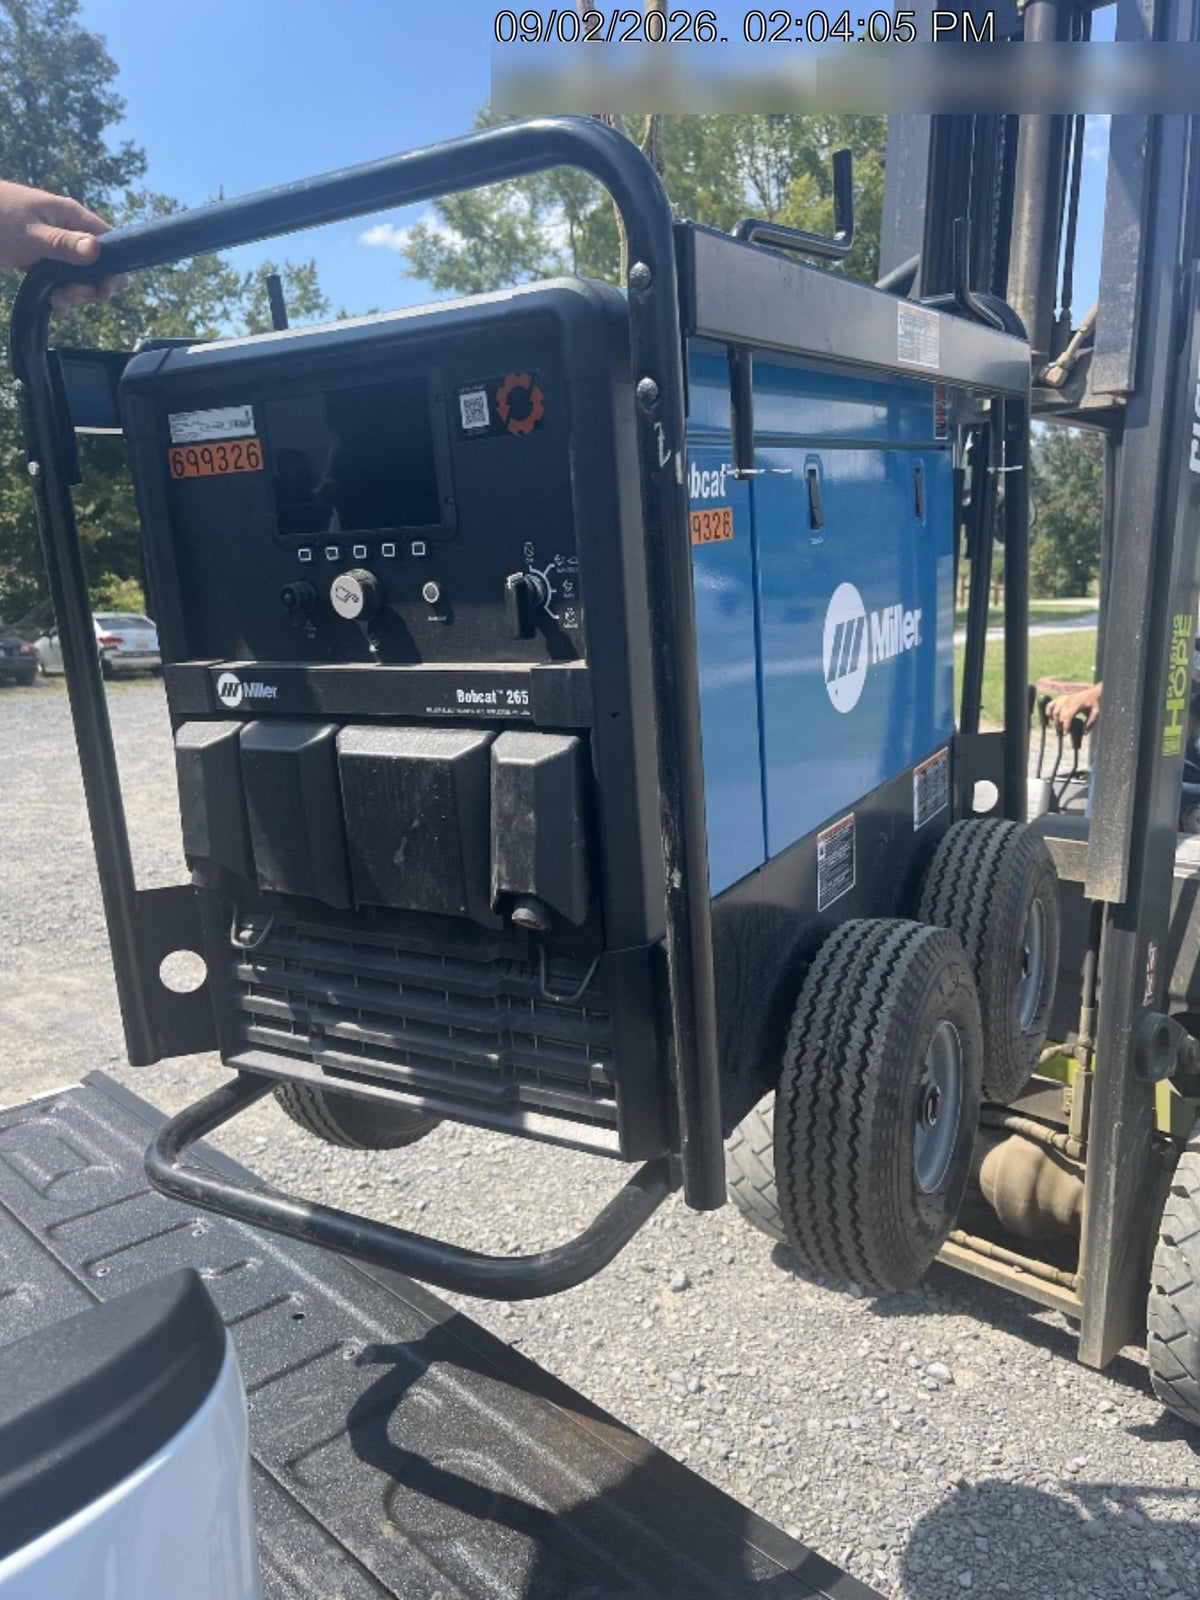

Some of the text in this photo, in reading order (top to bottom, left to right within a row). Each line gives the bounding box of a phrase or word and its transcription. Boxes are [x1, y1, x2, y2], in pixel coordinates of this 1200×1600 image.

[172, 442, 260, 476] 699326
[870, 603, 922, 664] Miller
[243, 682, 278, 698] Miller
[1163, 614, 1193, 737] HOPE
[506, 690, 529, 704] 265
